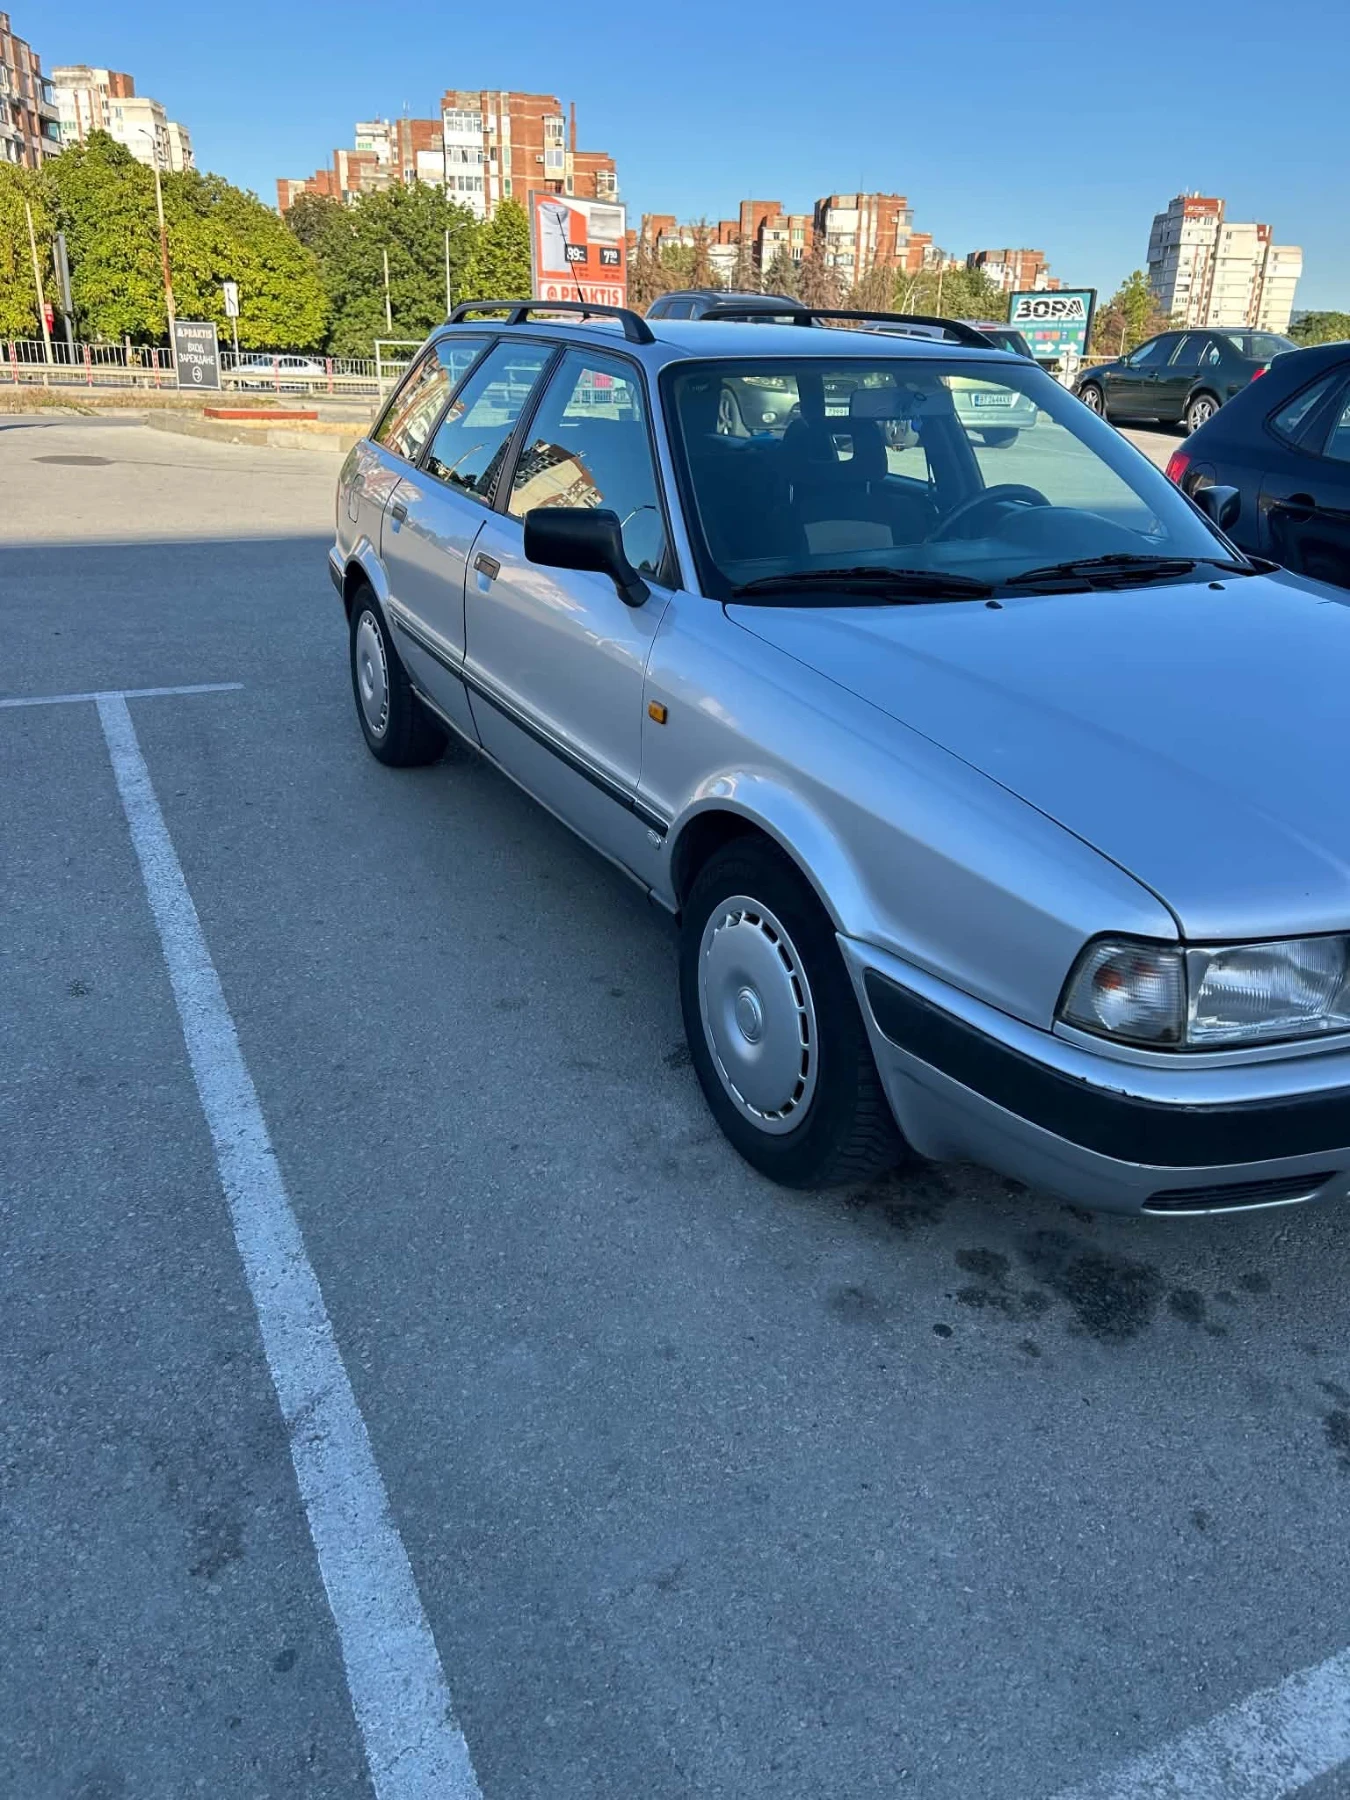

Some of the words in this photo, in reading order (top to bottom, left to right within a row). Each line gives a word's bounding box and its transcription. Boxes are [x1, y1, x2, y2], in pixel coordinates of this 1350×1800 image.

[561, 286, 619, 306] PRAKTIS
[1016, 299, 1084, 318] ЗОРА
[184, 328, 213, 339] PRAKTIS
